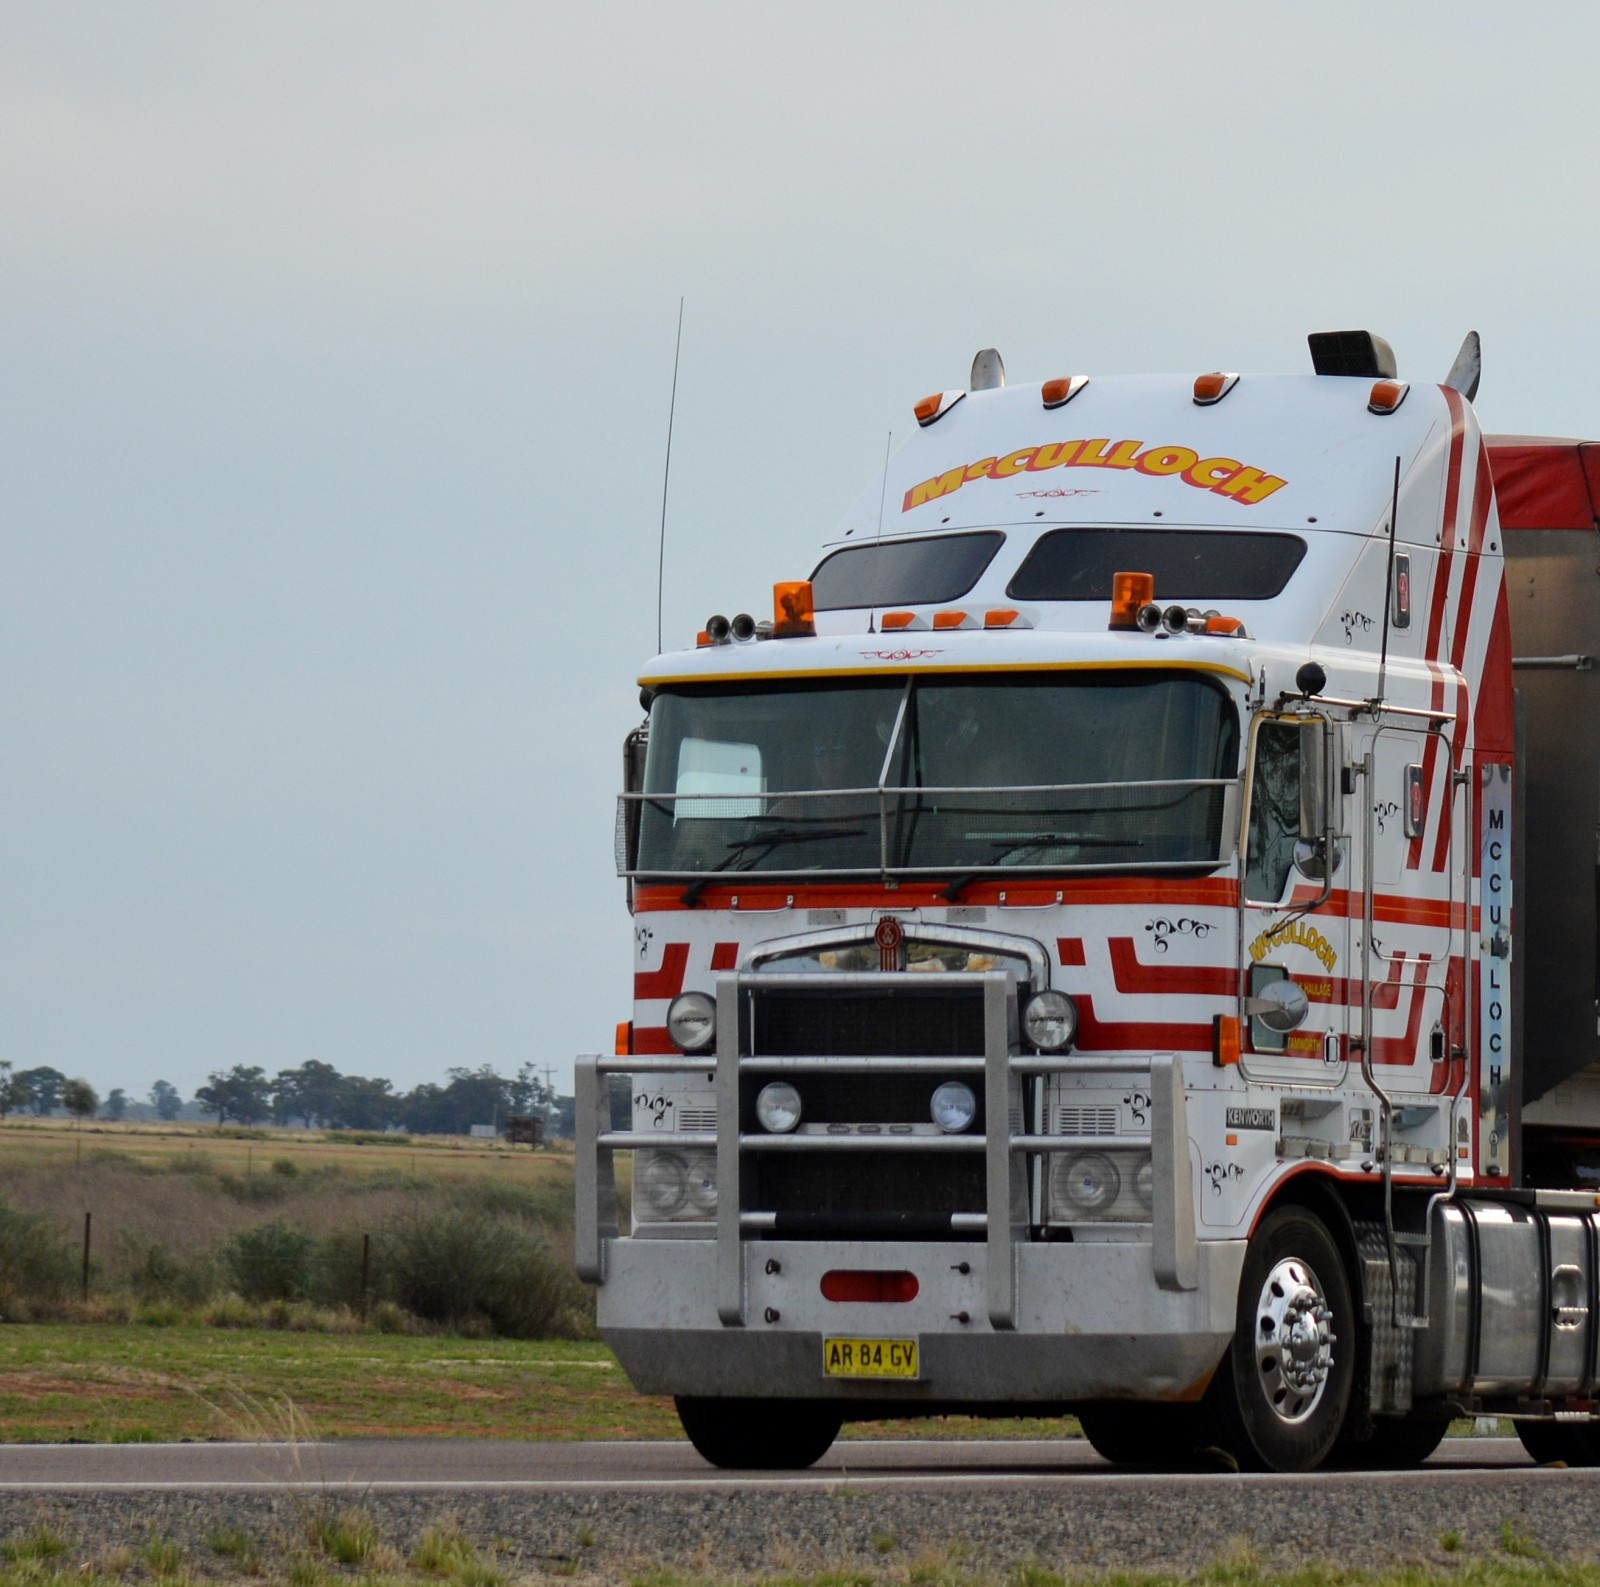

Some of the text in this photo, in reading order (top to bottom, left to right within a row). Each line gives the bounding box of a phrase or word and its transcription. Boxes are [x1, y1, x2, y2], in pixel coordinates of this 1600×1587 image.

[1489, 808, 1504, 1086] MCCULLOCH
[1227, 1108, 1274, 1127] KENWORTH
[830, 1343, 914, 1367] AR 84 GV
